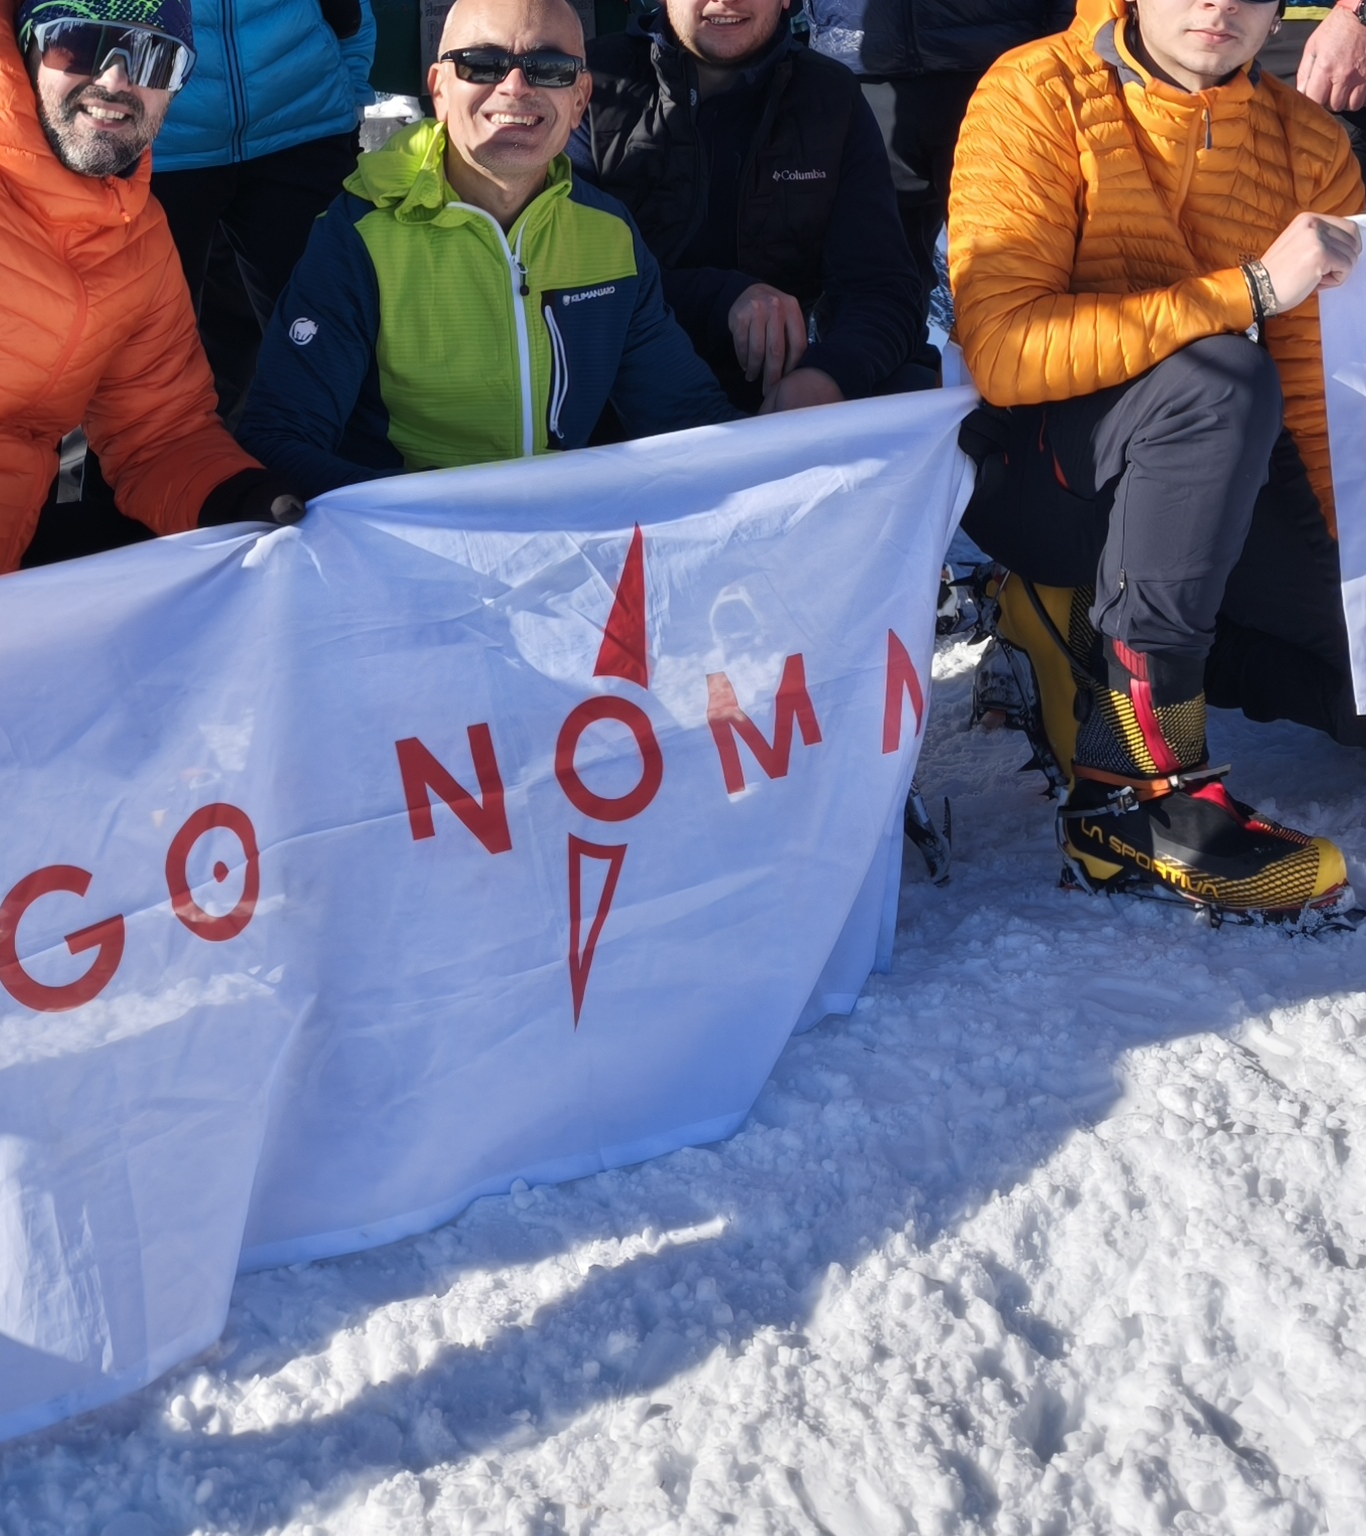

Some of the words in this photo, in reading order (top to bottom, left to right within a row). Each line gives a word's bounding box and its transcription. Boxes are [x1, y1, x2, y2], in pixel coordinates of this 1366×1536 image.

[781, 168, 826, 181] Columbia
[1081, 816, 1105, 844] LA
[1108, 834, 1220, 899] SPORTIVA
